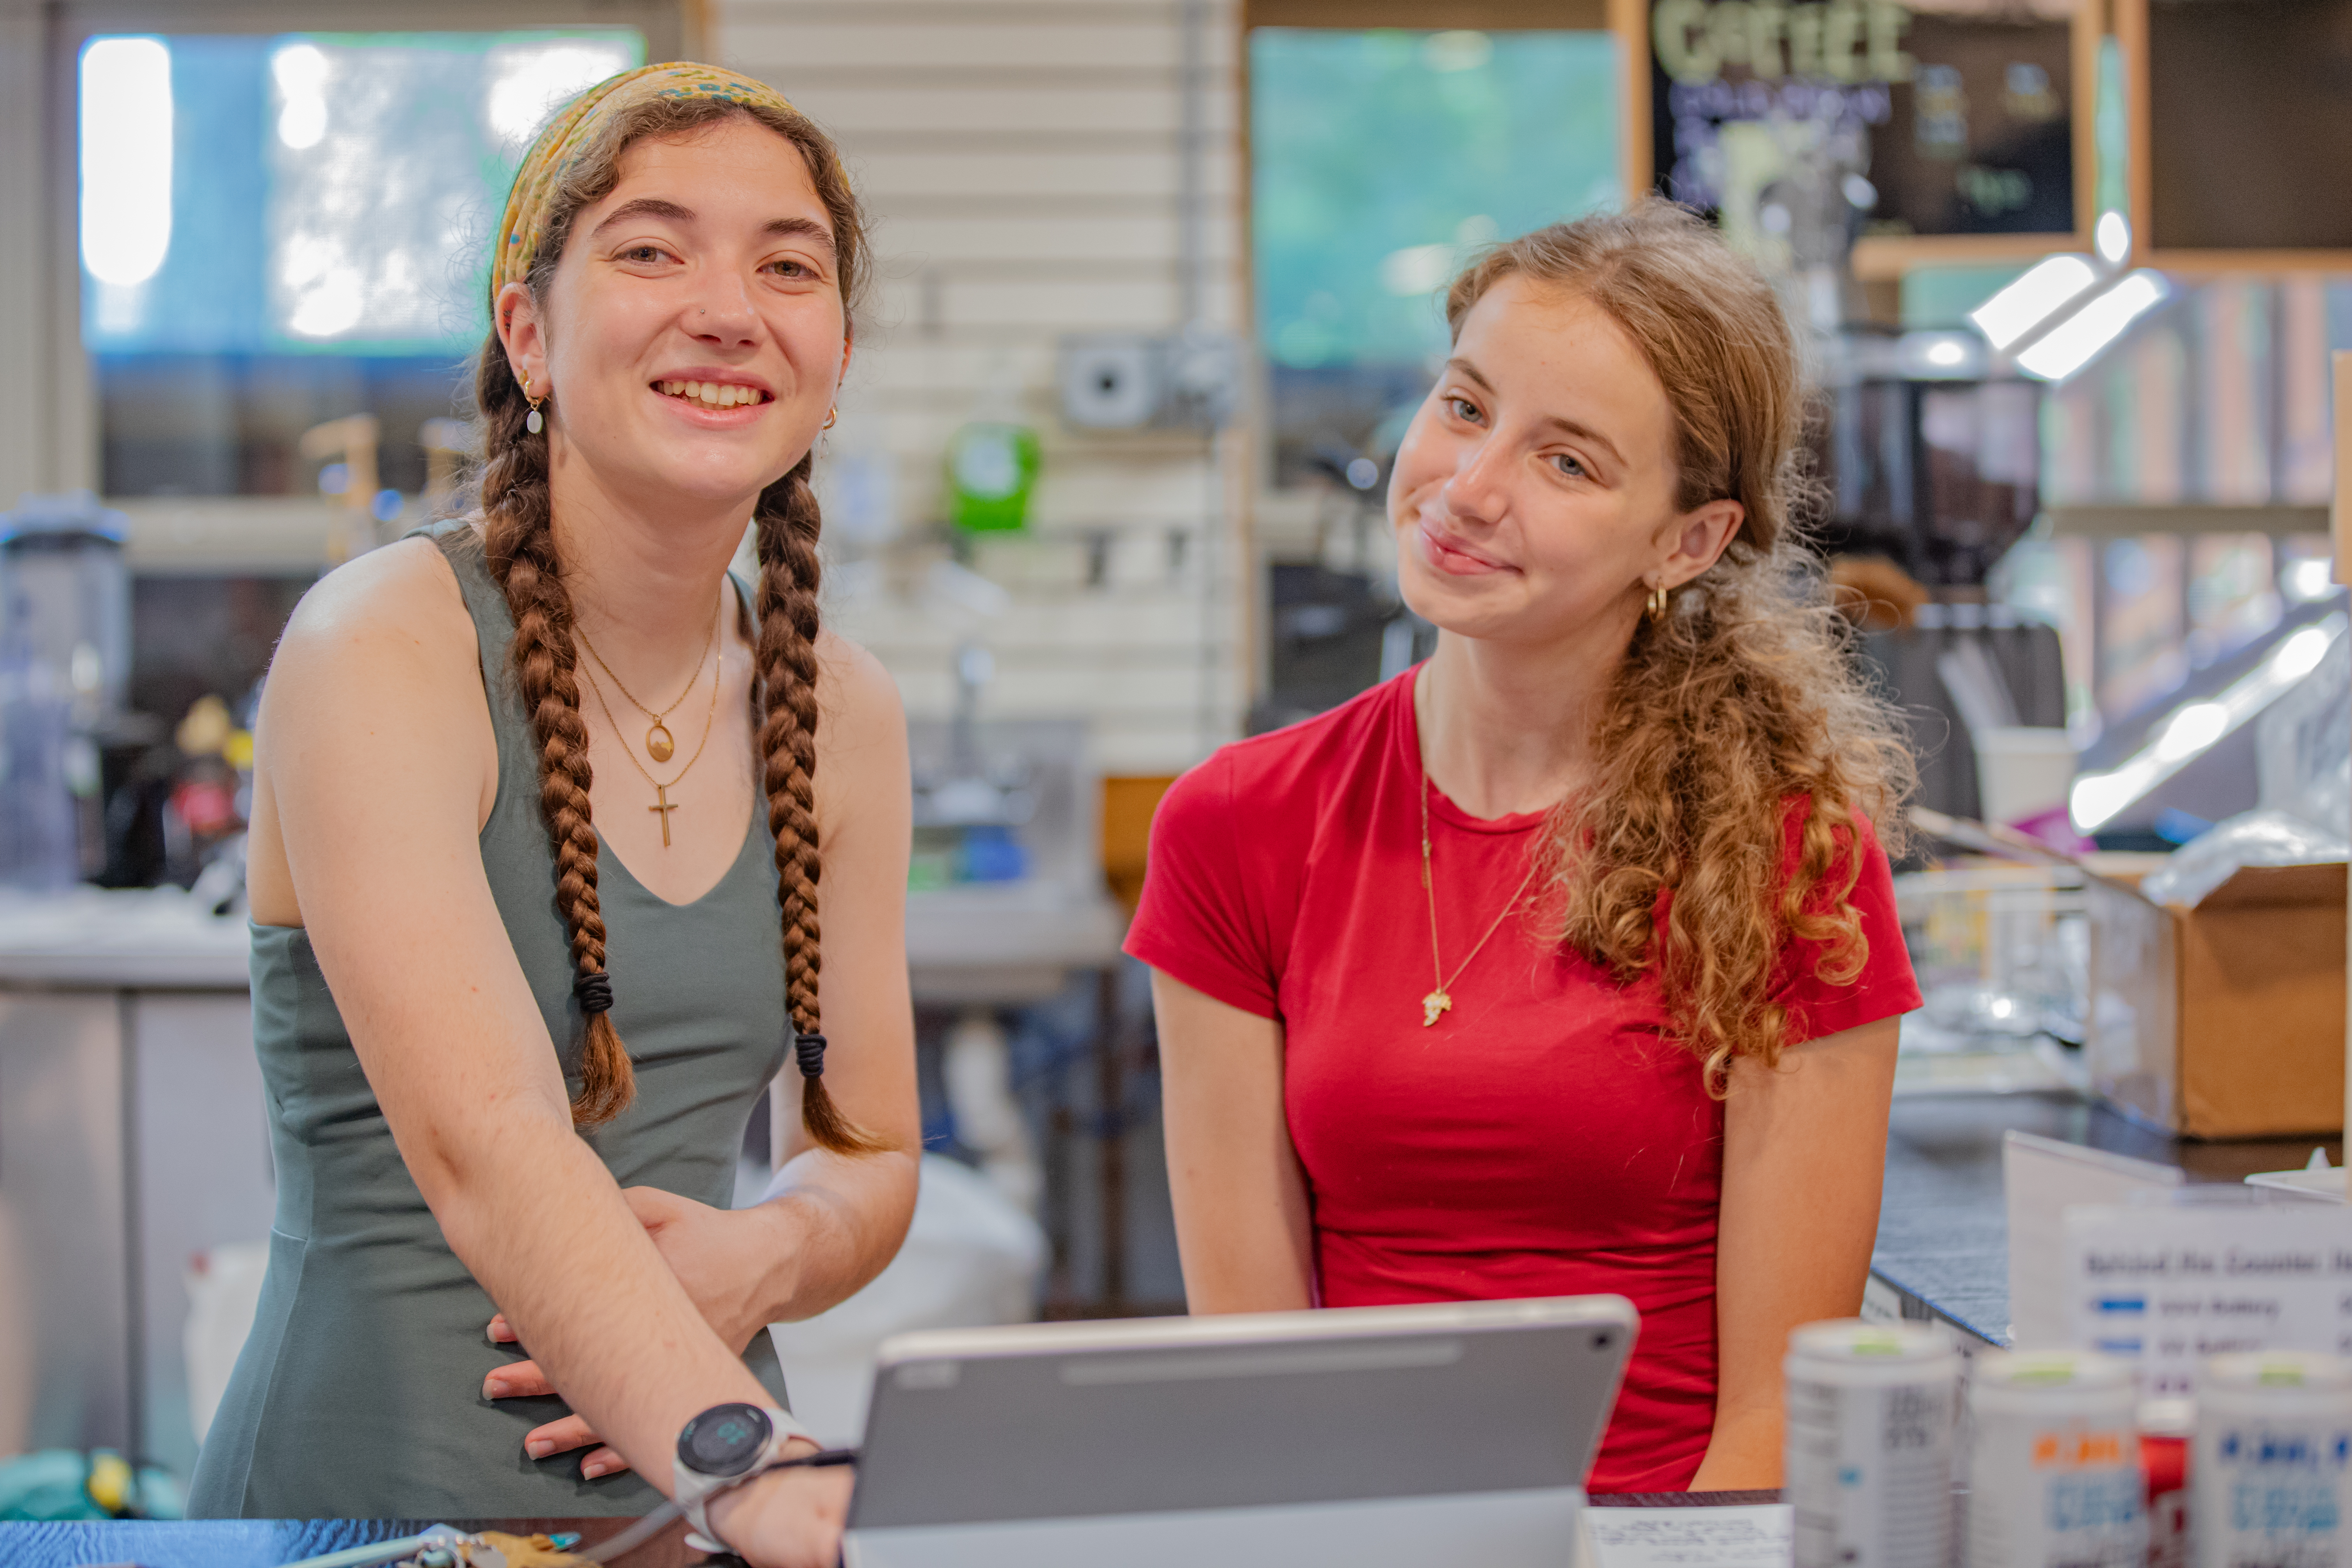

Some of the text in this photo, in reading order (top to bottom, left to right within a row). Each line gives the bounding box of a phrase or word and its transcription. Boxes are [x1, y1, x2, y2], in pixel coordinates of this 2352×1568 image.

[2084, 1249, 2168, 1274] Behind
[2180, 1249, 2214, 1274] the
[2227, 1249, 2320, 1274] Counter
